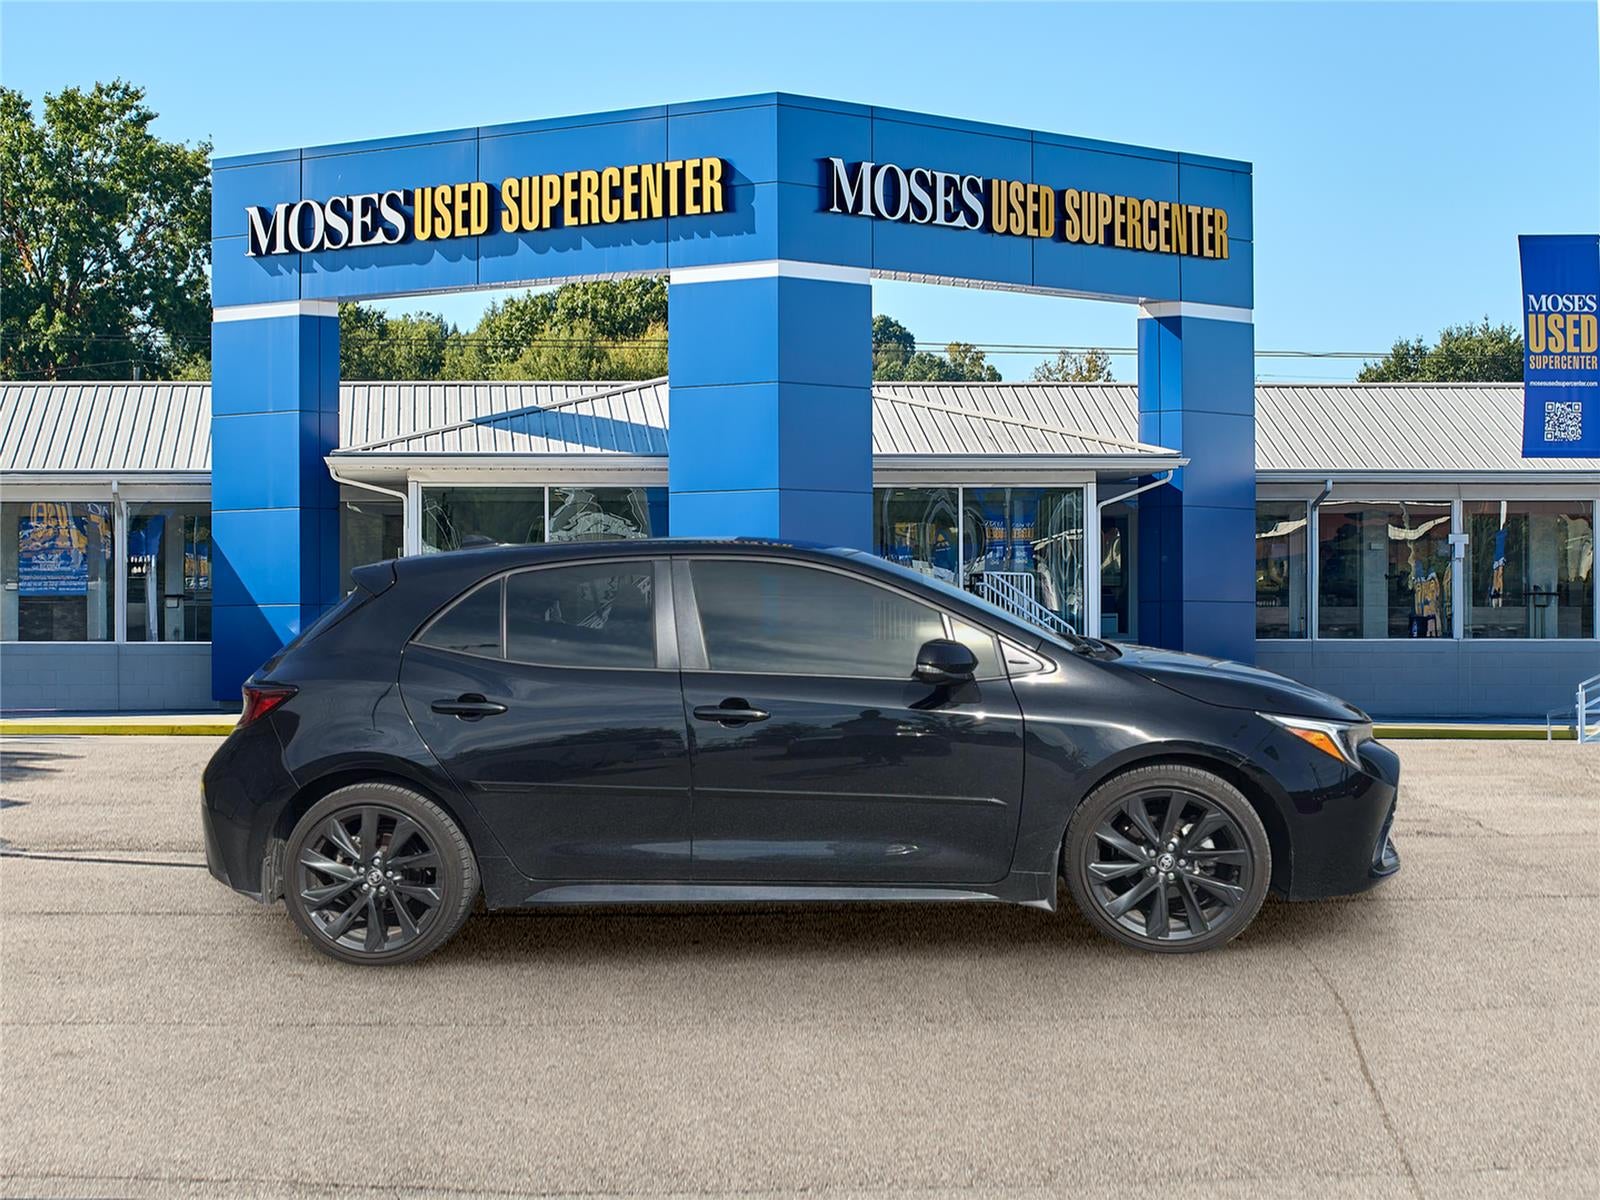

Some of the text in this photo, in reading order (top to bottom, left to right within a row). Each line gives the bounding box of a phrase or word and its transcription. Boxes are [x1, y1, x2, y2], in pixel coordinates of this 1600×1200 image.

[245, 157, 724, 256] MOSES USED SUPERCENTER
[829, 157, 1229, 259] MOSES USED SUPERCENTER
[1528, 294, 1597, 312] MOSES
[1528, 314, 1598, 353] USED
[1529, 355, 1598, 369] SUPERCENTER
